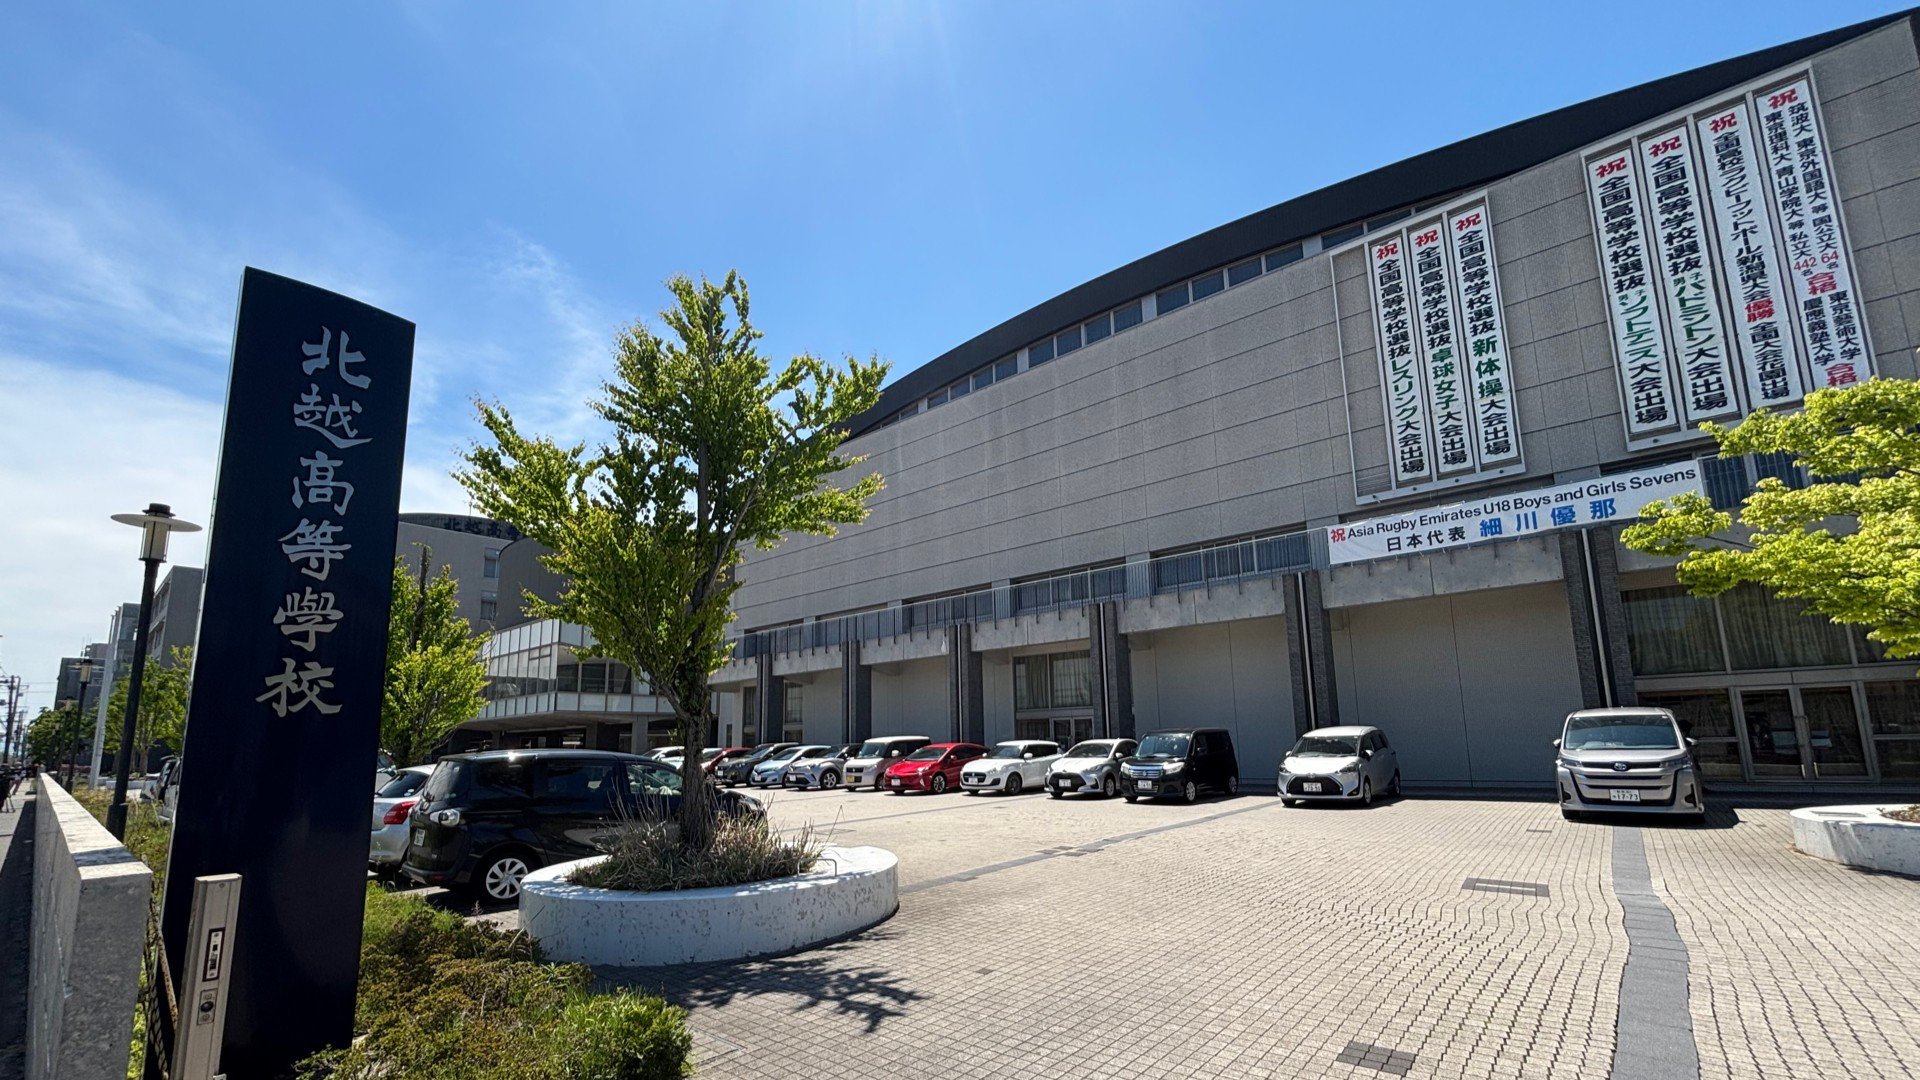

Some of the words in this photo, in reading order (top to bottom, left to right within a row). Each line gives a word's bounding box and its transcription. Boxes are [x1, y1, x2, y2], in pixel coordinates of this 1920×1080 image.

[256, 325, 373, 718] 北越高等學校
[1330, 528, 1346, 543] 祝
[1348, 525, 1374, 539] Asia
[1376, 518, 1417, 534] Rugby
[1419, 506, 1482, 527] Emirates
[1484, 500, 1511, 514] U18
[1514, 494, 1551, 510] Boys
[1554, 487, 1584, 502] and
[1586, 480, 1626, 497] Girls
[1630, 469, 1696, 490] Sevens
[1387, 526, 1466, 552] 日本代表
